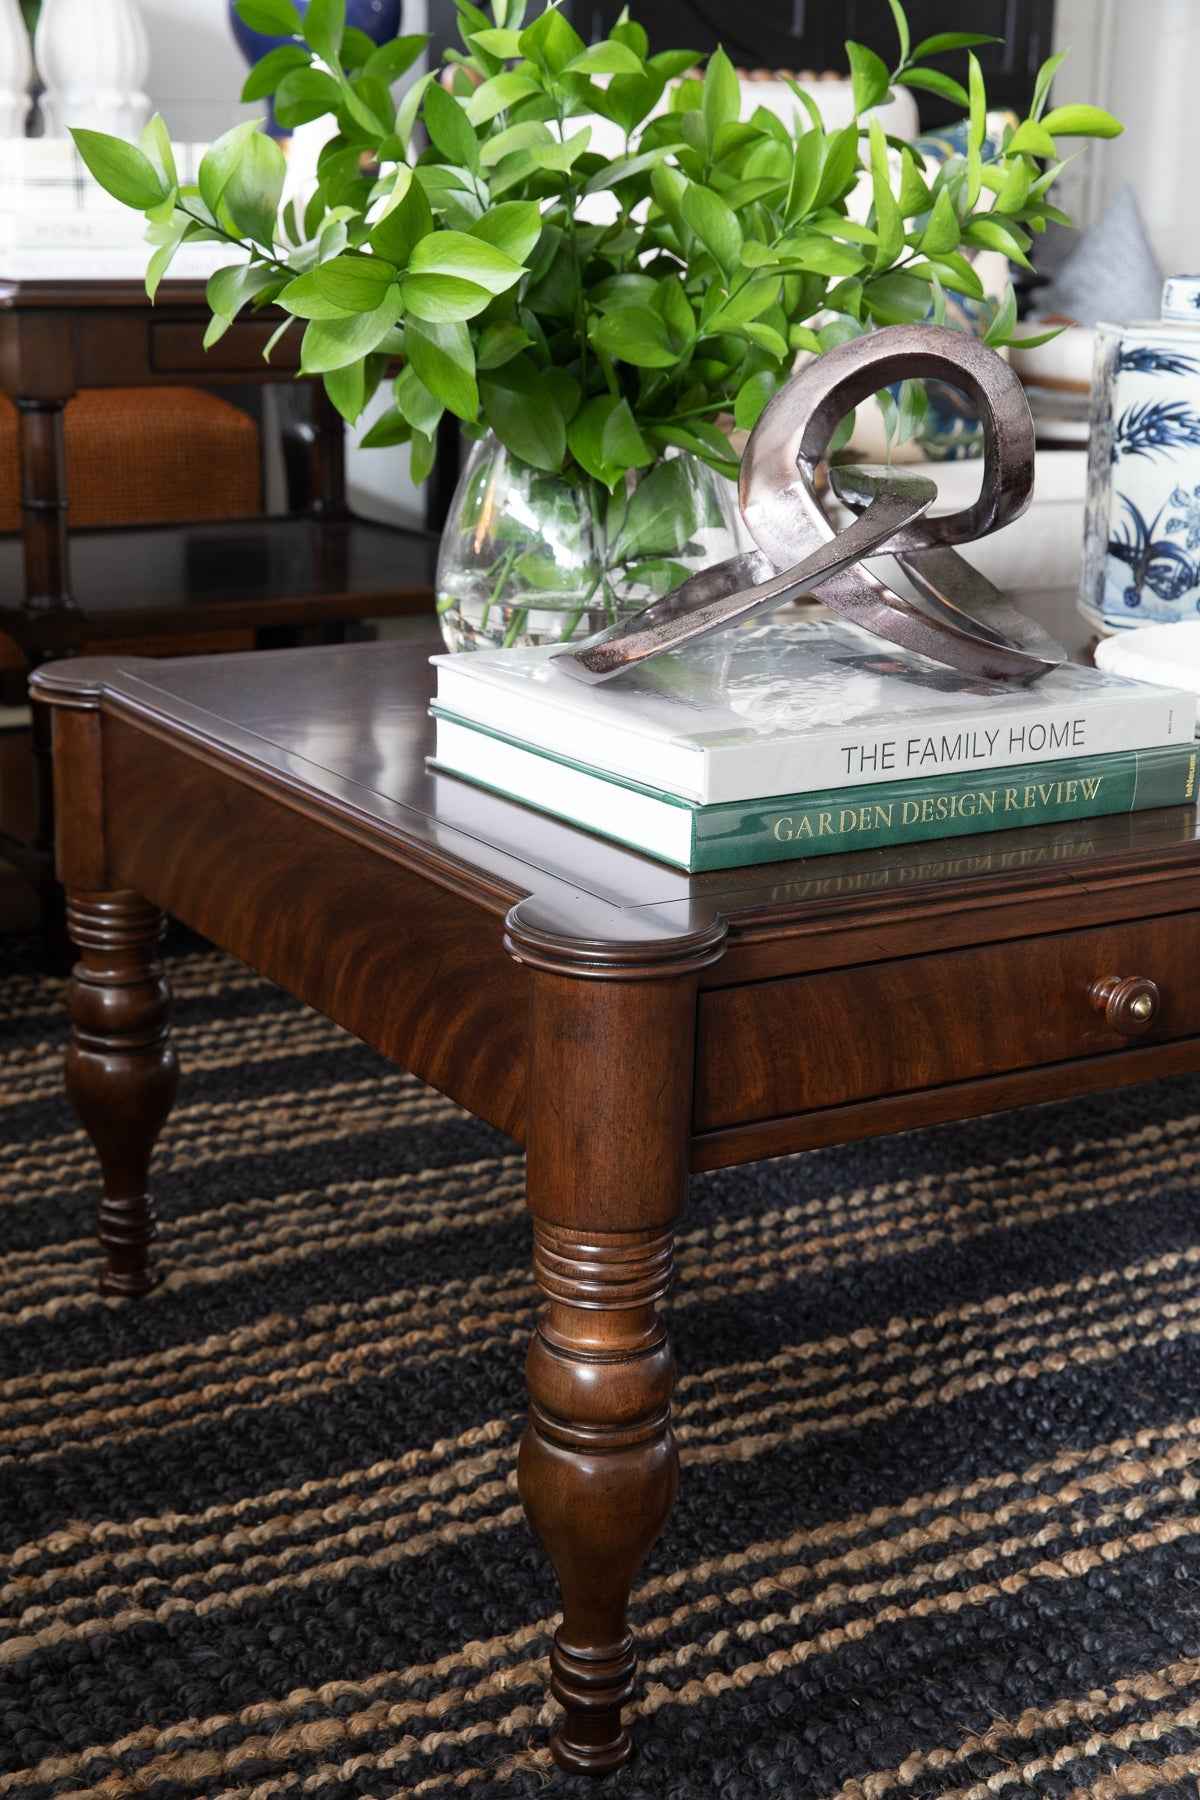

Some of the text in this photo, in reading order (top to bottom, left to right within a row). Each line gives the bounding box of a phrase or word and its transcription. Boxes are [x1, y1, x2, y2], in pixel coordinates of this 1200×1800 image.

[841, 719, 1086, 774] THE FAMILY HOME
[773, 775, 1104, 842] GARDEN DESIGN REVIEW
